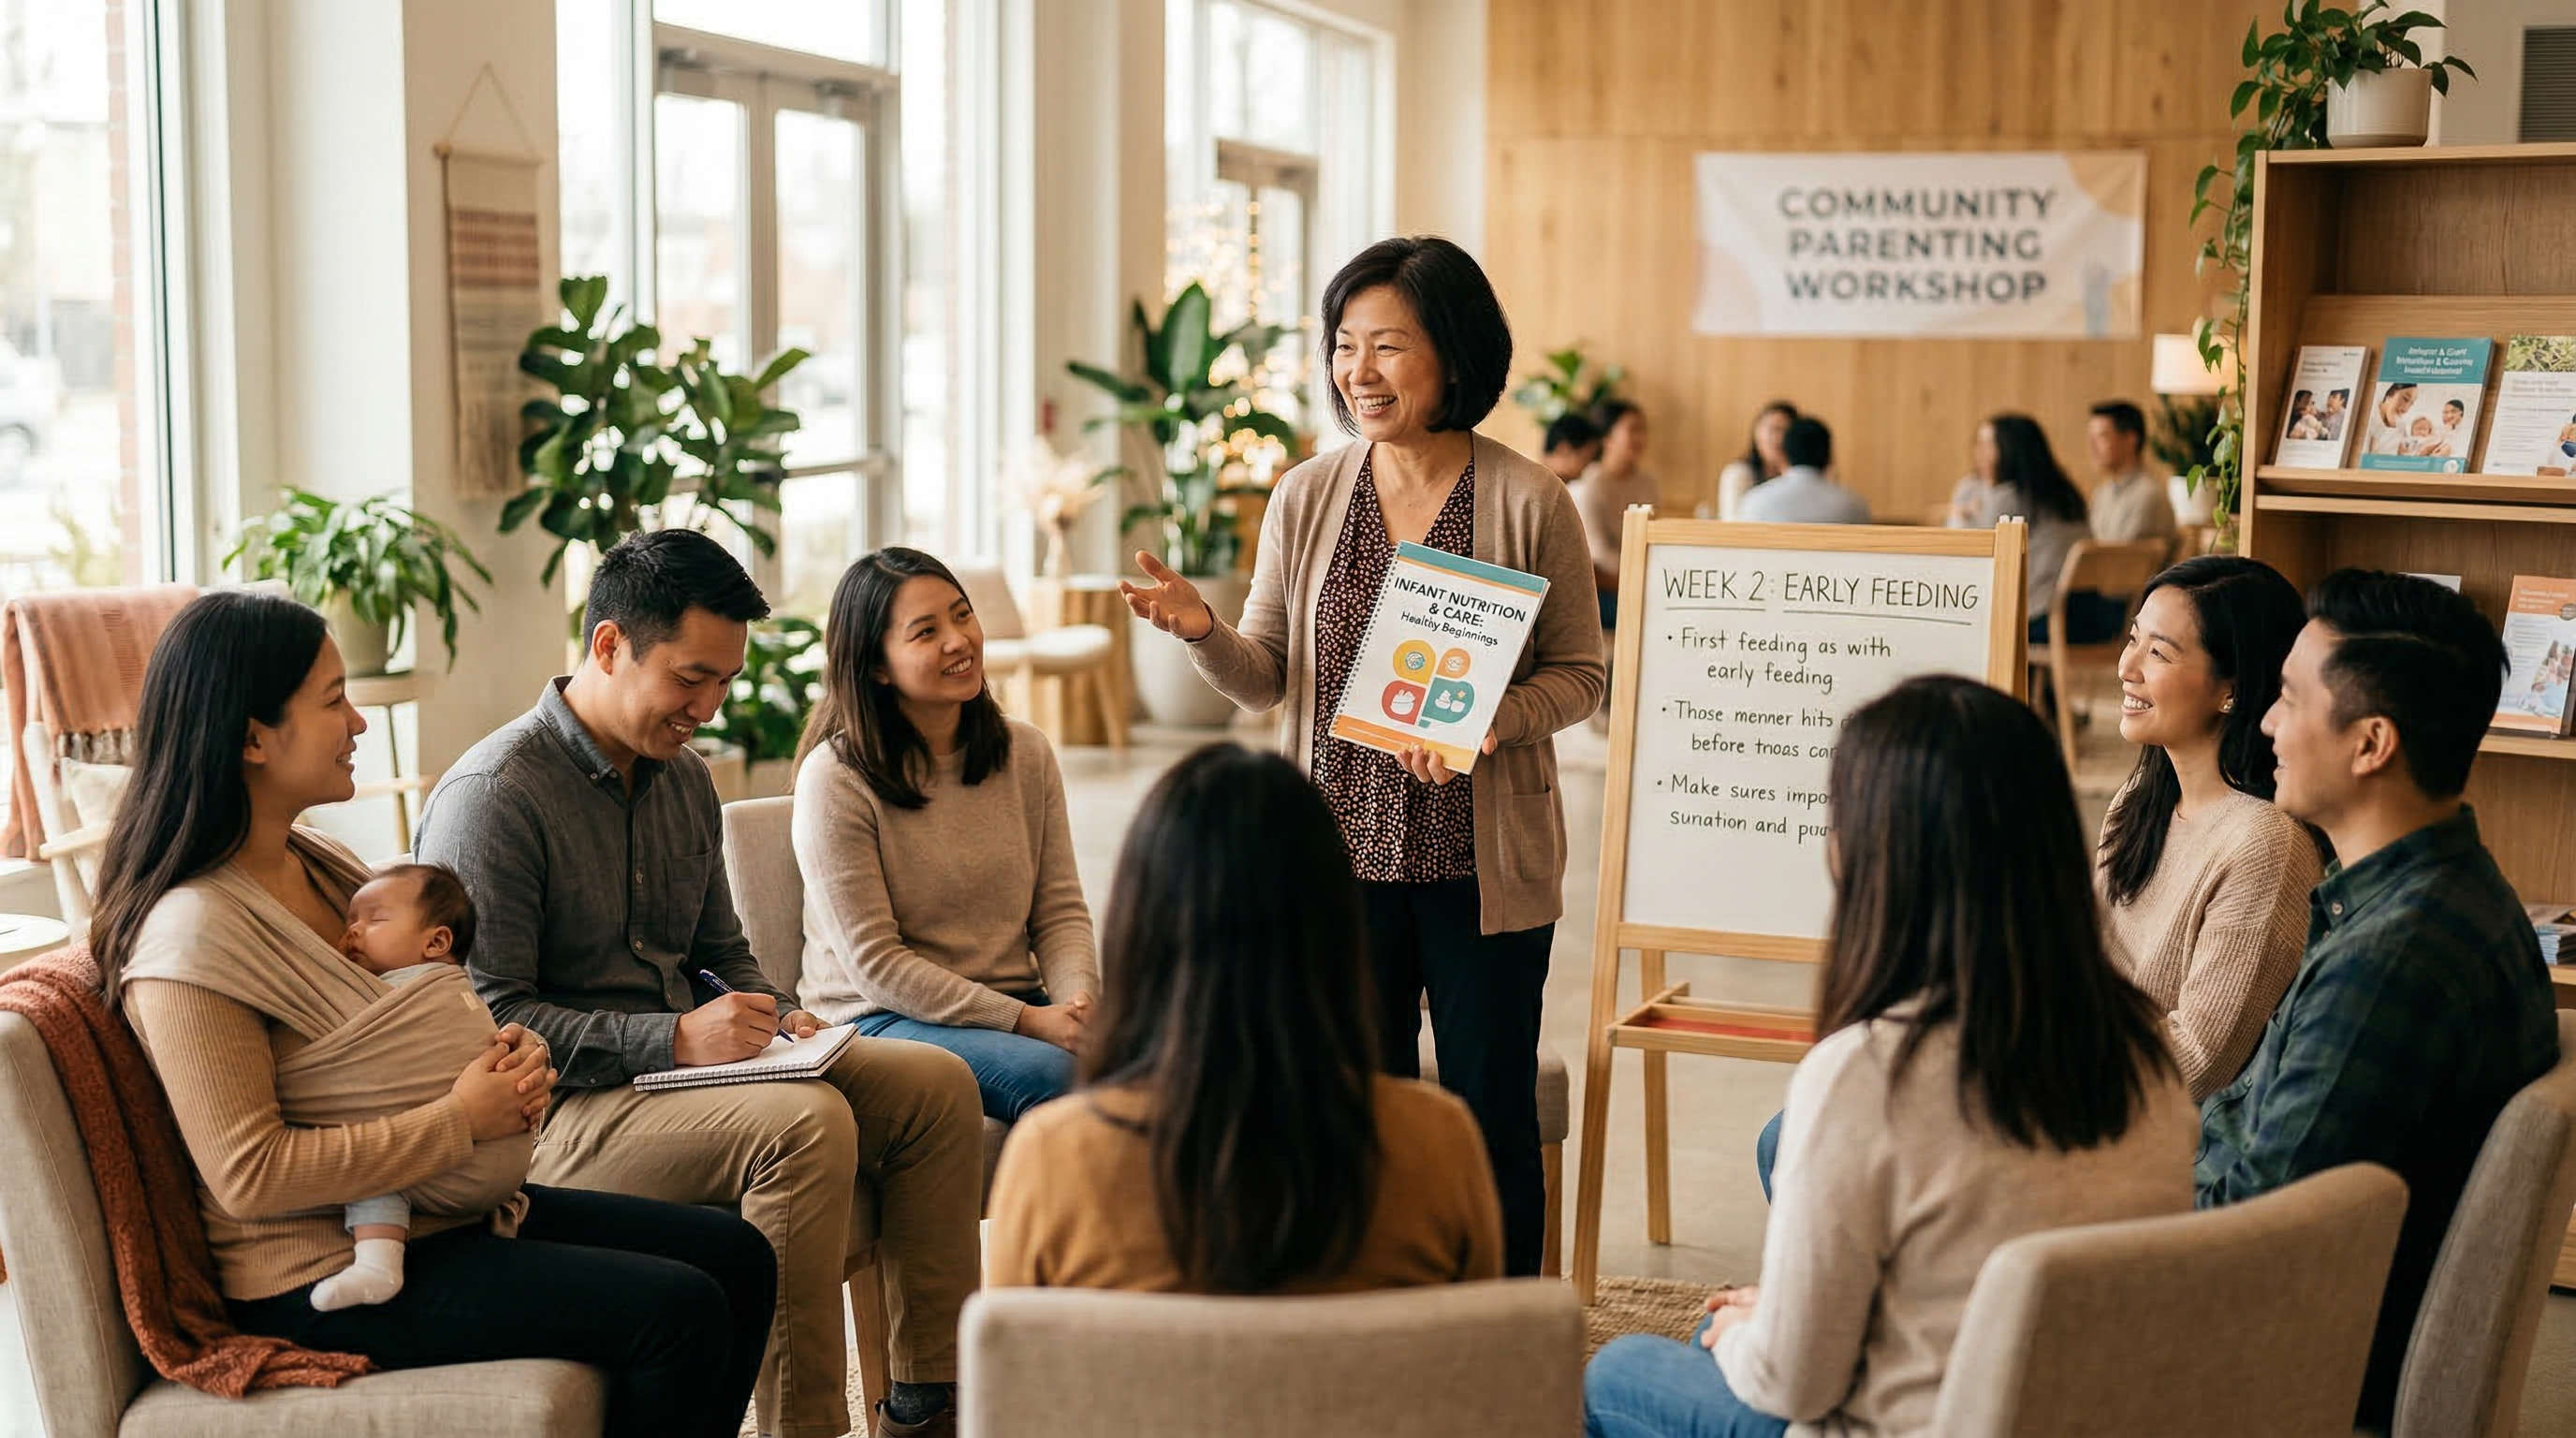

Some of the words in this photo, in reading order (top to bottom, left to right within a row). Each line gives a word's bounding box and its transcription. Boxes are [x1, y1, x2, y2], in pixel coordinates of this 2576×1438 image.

[1779, 187, 2057, 220] COMMUNITY
[1789, 229, 2042, 261] PARENTING
[1785, 271, 2047, 303] WORKSHOP
[1394, 577, 1447, 600] INFANT
[1448, 592, 1527, 623] NUTRITION
[1662, 568, 1737, 599] WEEK
[1784, 573, 1860, 605] EARLY
[1871, 578, 1979, 609] FEEDING
[1400, 610, 1441, 632] Healthy
[1442, 622, 1498, 646] Beginnings
[1428, 602, 1440, 615] &
[1442, 607, 1485, 627] CARE:
[1681, 626, 1729, 650] First
[1738, 632, 1808, 665] feeding
[1818, 641, 1837, 654] as
[1847, 636, 1891, 657] with
[1707, 661, 1754, 688] early
[1764, 662, 1833, 696] feeding
[1674, 700, 1724, 722] Those
[1734, 711, 1793, 726] menner
[1691, 732, 1745, 754] before
[1671, 773, 1720, 797] Make
[1731, 785, 1776, 801] sures
[1786, 786, 1831, 811] impo
[1670, 810, 1747, 830] sunation
[1755, 817, 1787, 834] and
